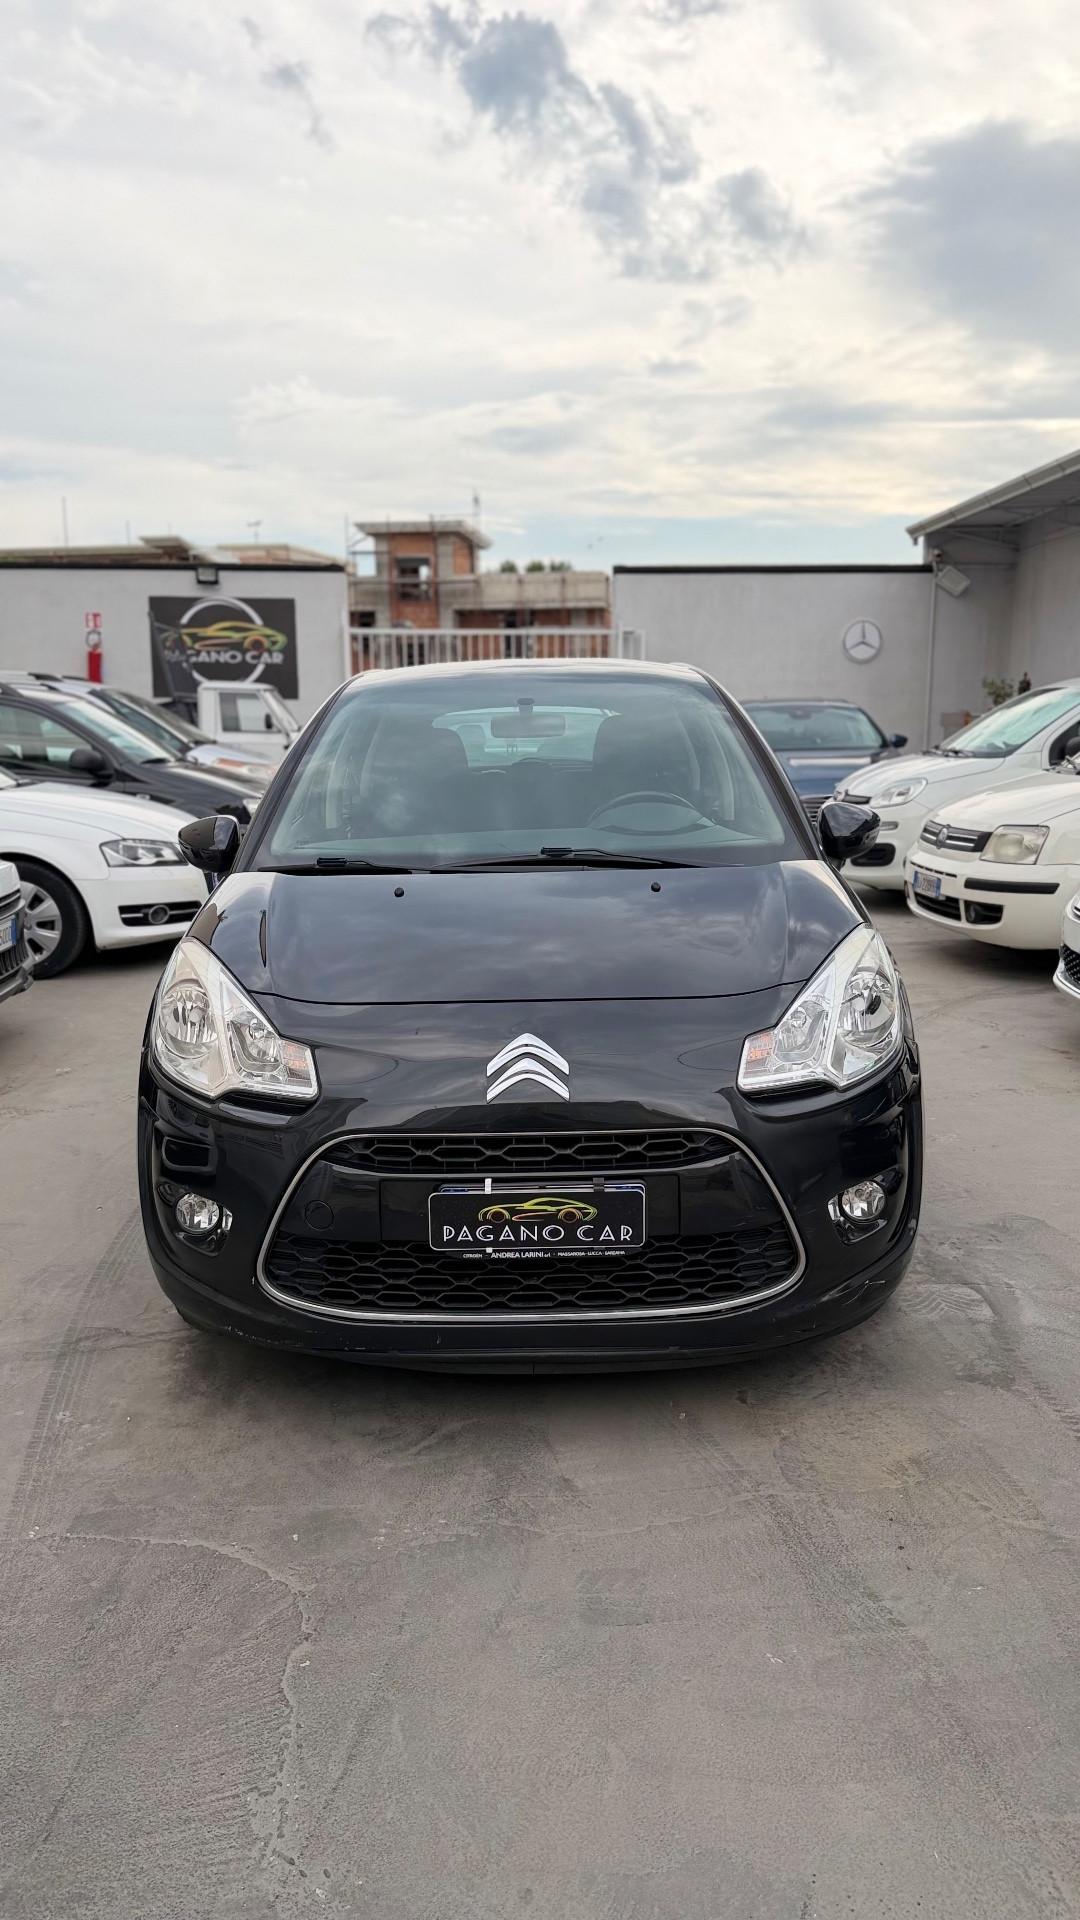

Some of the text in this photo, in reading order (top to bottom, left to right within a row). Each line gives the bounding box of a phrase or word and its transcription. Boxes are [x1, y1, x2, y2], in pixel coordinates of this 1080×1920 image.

[245, 650, 284, 664] CAR
[443, 1225, 633, 1242] PAGANO CAR
